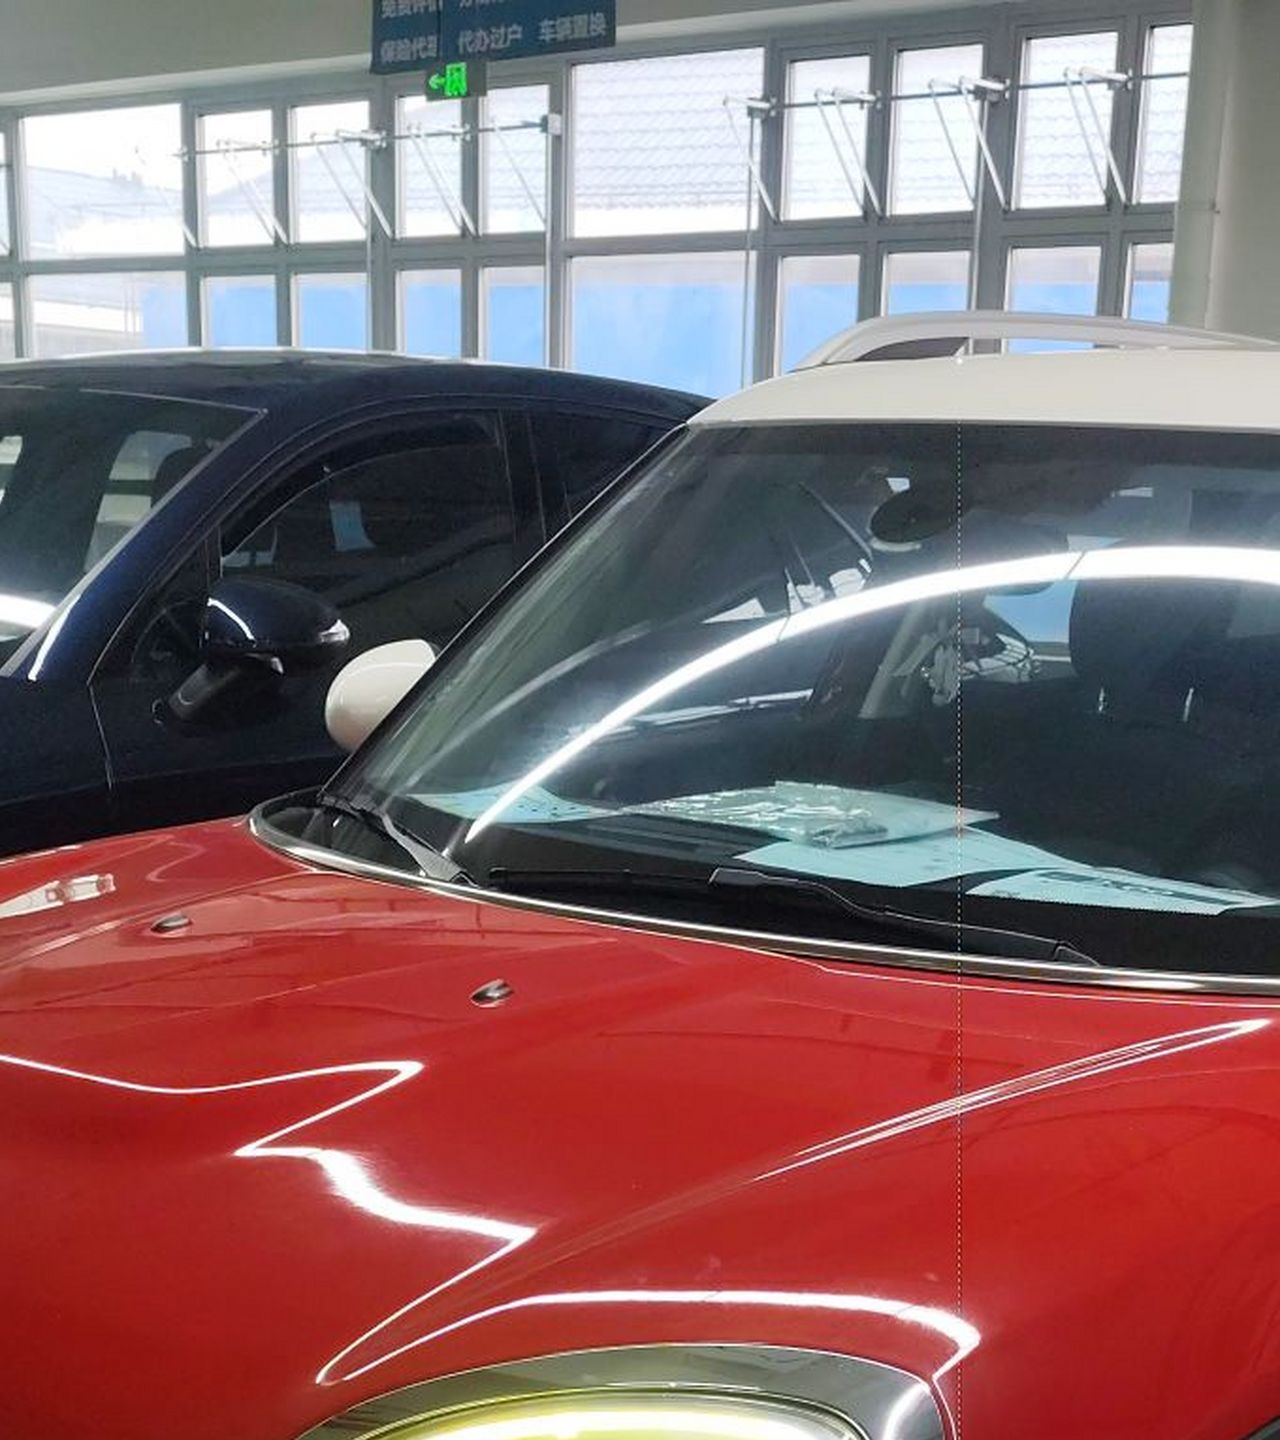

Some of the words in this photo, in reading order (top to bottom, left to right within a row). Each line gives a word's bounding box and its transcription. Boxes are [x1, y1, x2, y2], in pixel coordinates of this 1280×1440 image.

[458, 23, 523, 55] 代办过户
[538, 11, 606, 43] 车辆置换
